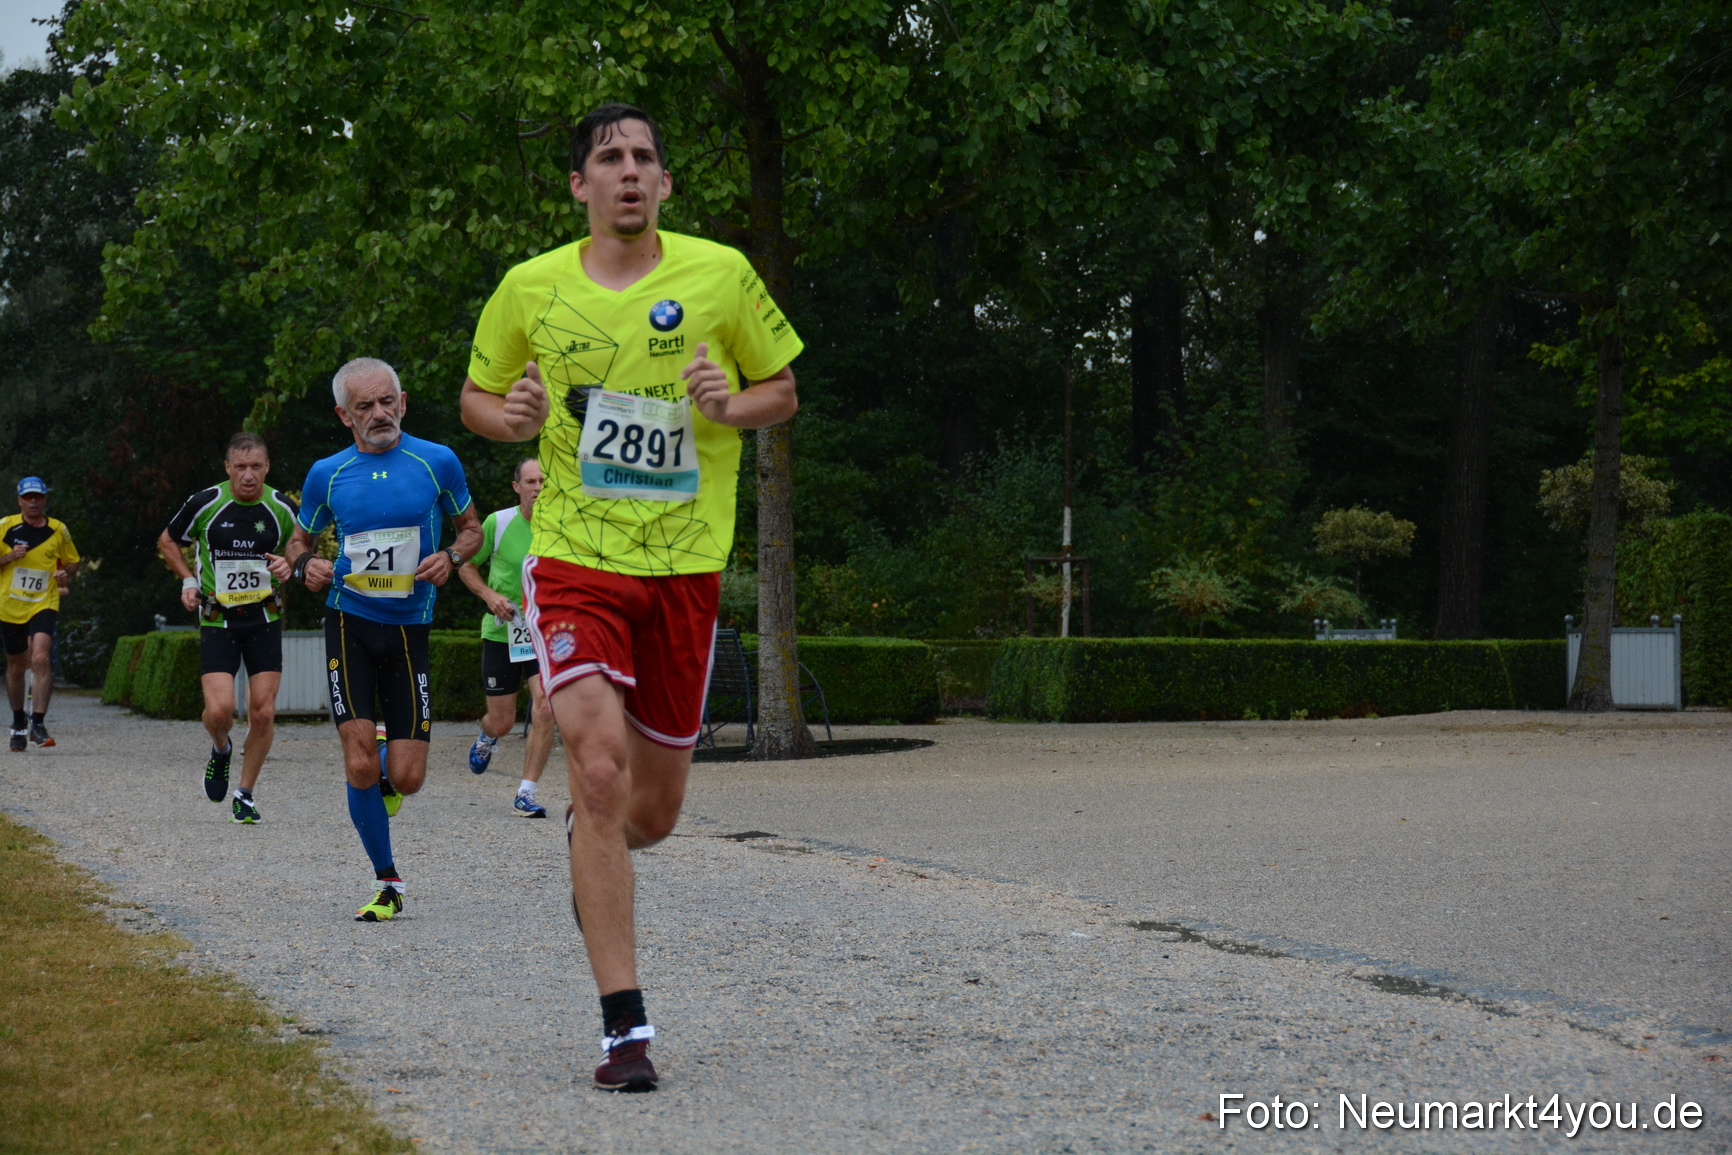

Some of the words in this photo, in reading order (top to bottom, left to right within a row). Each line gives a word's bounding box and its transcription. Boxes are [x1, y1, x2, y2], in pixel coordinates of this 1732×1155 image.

[648, 334, 684, 351] Partl
[472, 345, 491, 367] Partl
[649, 349, 684, 358] Neumarkt
[644, 383, 676, 398] NEXT
[592, 418, 685, 468] 2897
[603, 468, 674, 487] Christian
[232, 540, 255, 549] DAV
[365, 546, 394, 571] 21
[20, 576, 43, 590] 176
[226, 571, 260, 590] 235
[367, 577, 393, 588] Willi
[228, 593, 261, 602] Reinhard
[330, 670, 346, 716] SKINS
[417, 673, 430, 720] SKINS
